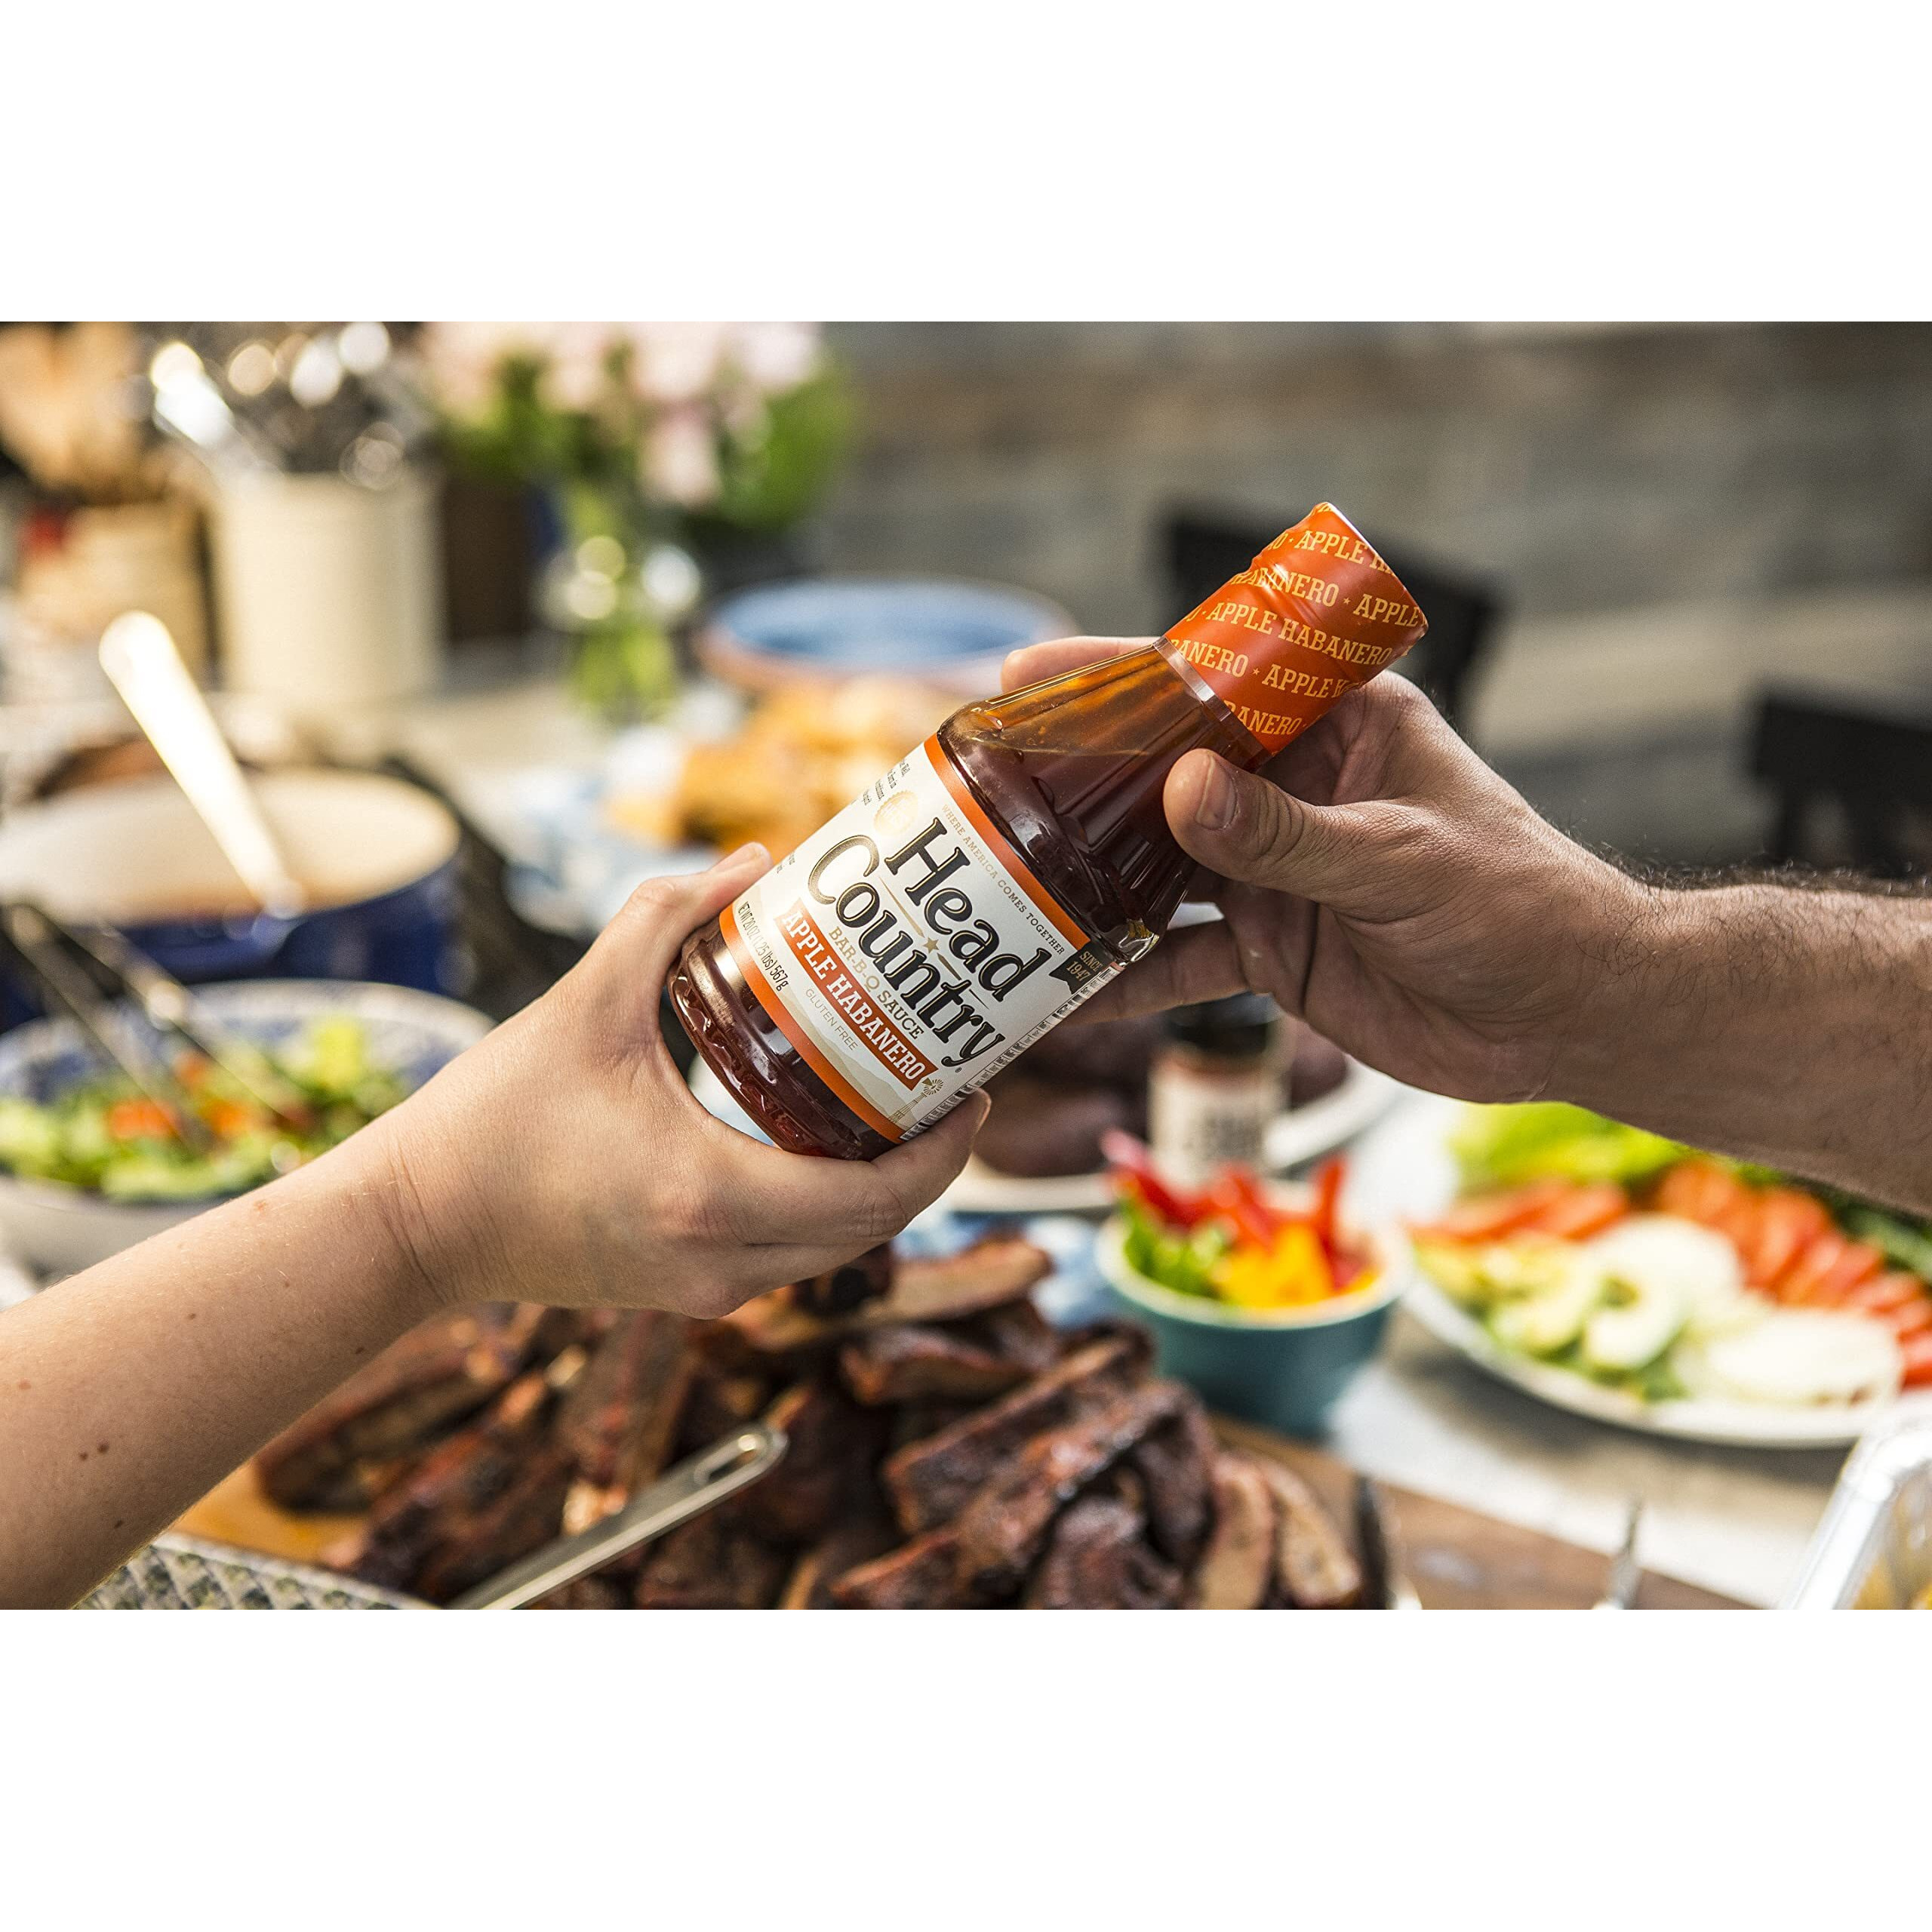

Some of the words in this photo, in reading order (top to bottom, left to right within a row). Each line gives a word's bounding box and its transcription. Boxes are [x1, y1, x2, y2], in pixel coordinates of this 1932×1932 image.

[1294, 531, 1367, 565] APPLE
[1229, 567, 1339, 607] HABANERO
[1353, 593, 1420, 627] APPLE
[1206, 602, 1277, 635] APPLE
[1278, 618, 1393, 665] HABANERO
[1262, 663, 1334, 698] APPLE
[884, 817, 1053, 1002] Head
[942, 804, 965, 835] WHERE
[963, 836, 998, 879] AMERICA
[998, 879, 1027, 913] COMES
[1026, 912, 1066, 955] TOGETHER
[761, 951, 778, 971] lbs)
[808, 834, 1006, 1068] Country
[1066, 961, 1092, 981] 1947
[1079, 951, 1103, 972] SINCE
[781, 911, 838, 980] APPLE
[826, 974, 926, 1080] HABANERO
[829, 926, 880, 992] BAR-B-Q
[877, 990, 924, 1040] SAUCE
[805, 988, 838, 1028] GLUTEN
[834, 1026, 859, 1051] FREE
